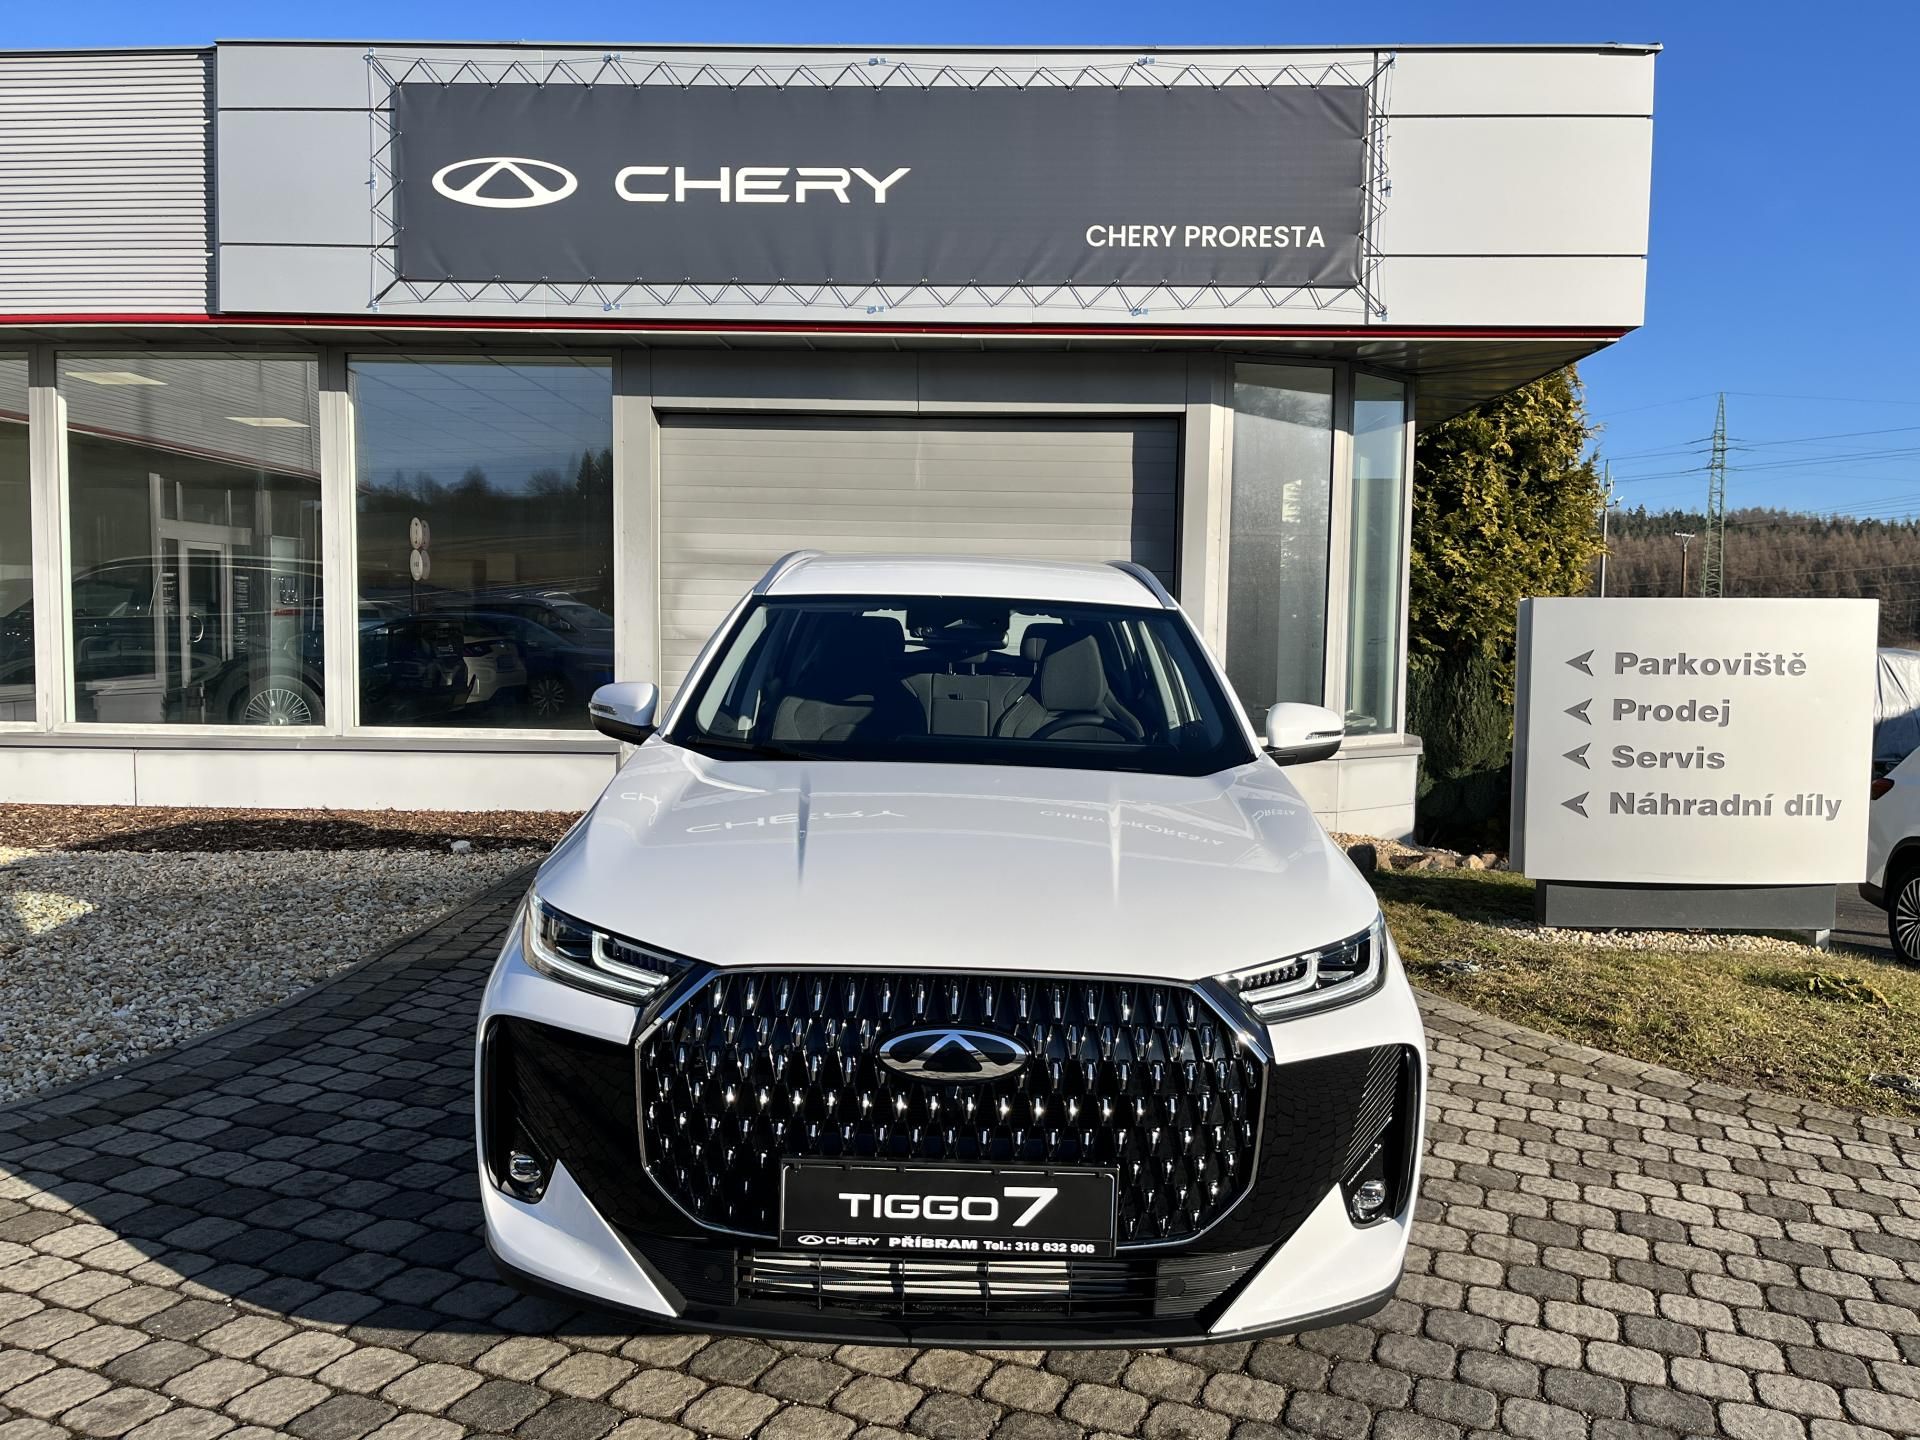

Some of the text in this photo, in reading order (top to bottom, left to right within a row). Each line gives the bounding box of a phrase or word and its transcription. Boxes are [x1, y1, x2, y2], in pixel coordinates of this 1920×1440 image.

[614, 165, 911, 204] CHERY
[1085, 224, 1326, 248] CHERY PRORESTA
[1613, 651, 1807, 677] Parkoviště
[1611, 698, 1731, 727] Prodej
[1610, 744, 1726, 770] Servis
[1608, 791, 1842, 822] Náhradní díly
[838, 1186, 1059, 1228] TIGGO 7
[825, 1236, 880, 1246] CHERY
[888, 1235, 979, 1250] PŘÍBRAM
[1015, 1241, 1040, 1252] 318
[1042, 1242, 1068, 1253] 632
[1070, 1243, 1096, 1254] 906
